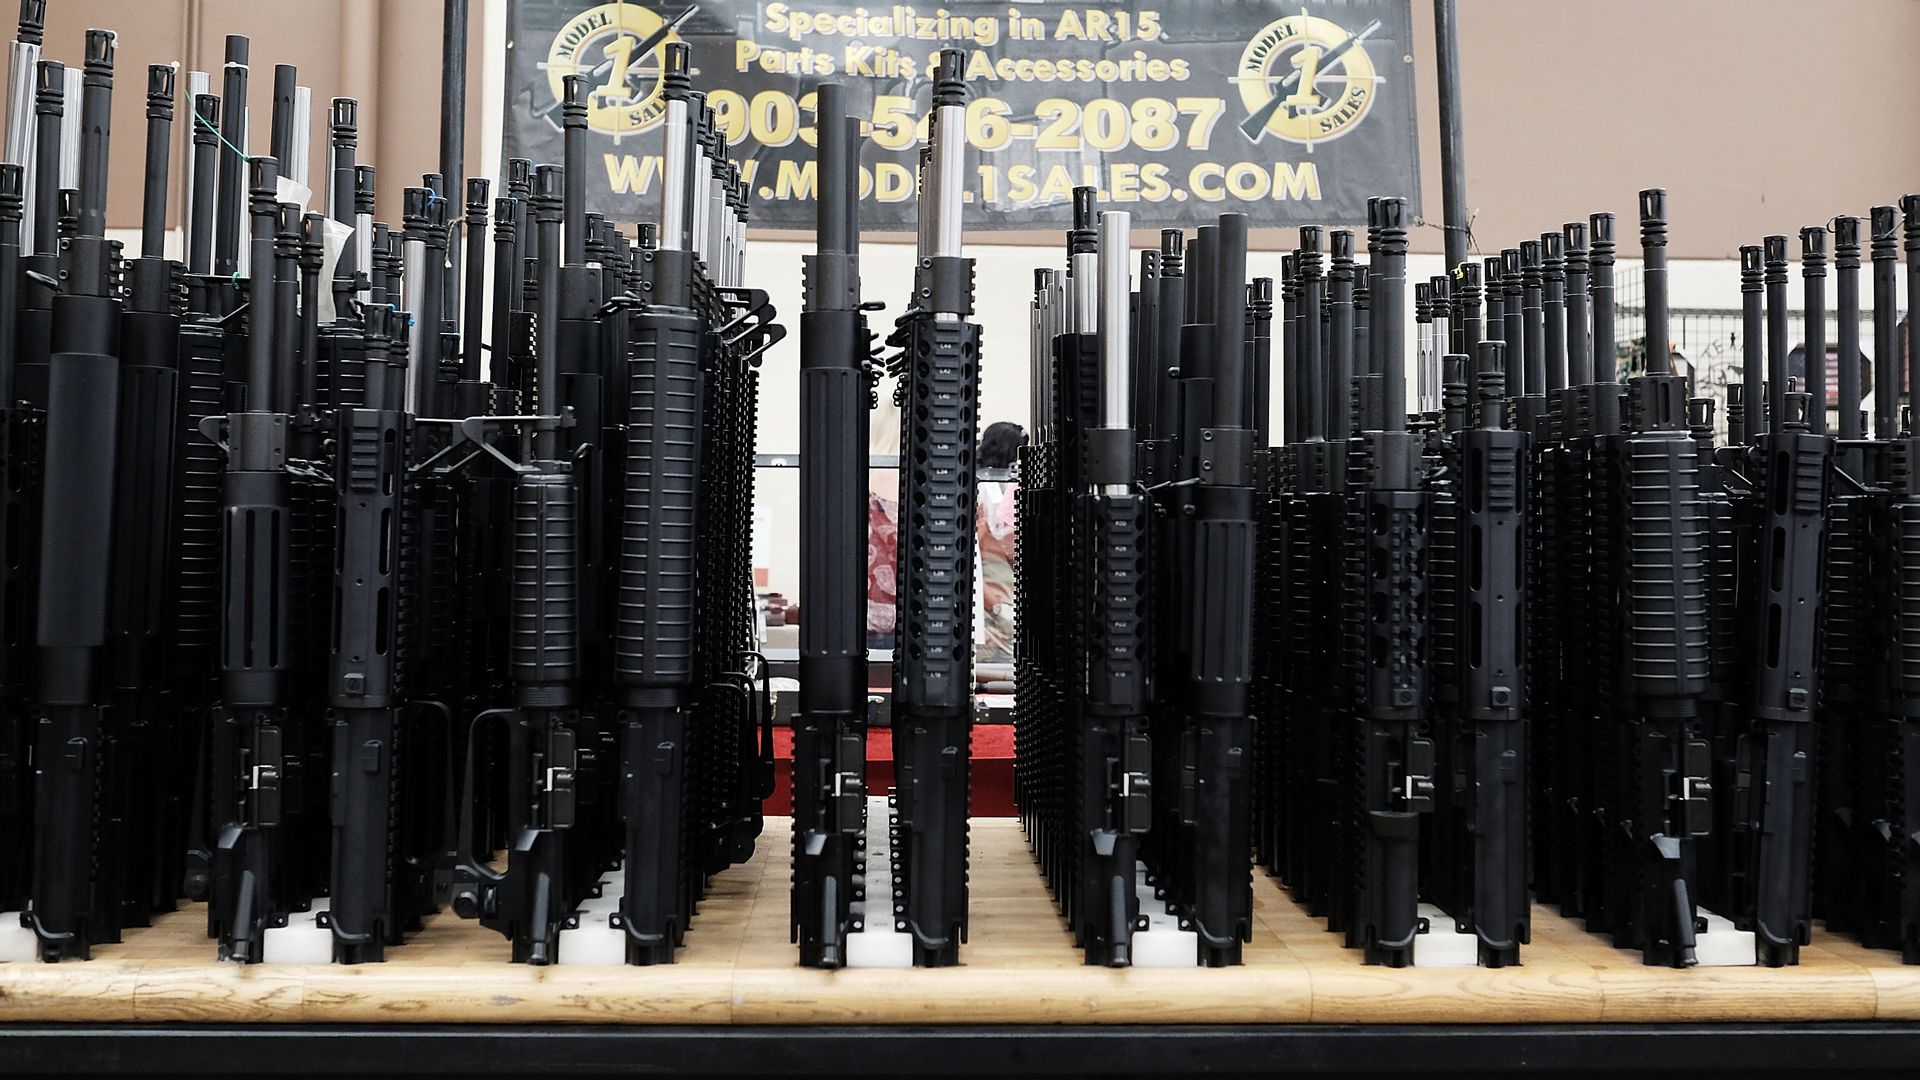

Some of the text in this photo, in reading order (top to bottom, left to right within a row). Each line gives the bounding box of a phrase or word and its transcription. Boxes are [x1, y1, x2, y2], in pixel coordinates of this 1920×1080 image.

[556, 11, 613, 60] MODEL
[764, 2, 1161, 46] Specializing in AR15
[1245, 24, 1299, 73] MODEL
[597, 36, 635, 97] 1
[735, 39, 835, 76] Parts
[845, 45, 917, 79] Kits
[965, 50, 1191, 82] Accessories
[1286, 46, 1322, 106] 1
[629, 100, 666, 126] SAL
[706, 89, 1226, 151] 9056-2087
[1319, 86, 1367, 133] SALES
[604, 153, 1323, 203] W.MD1SALES.COM
